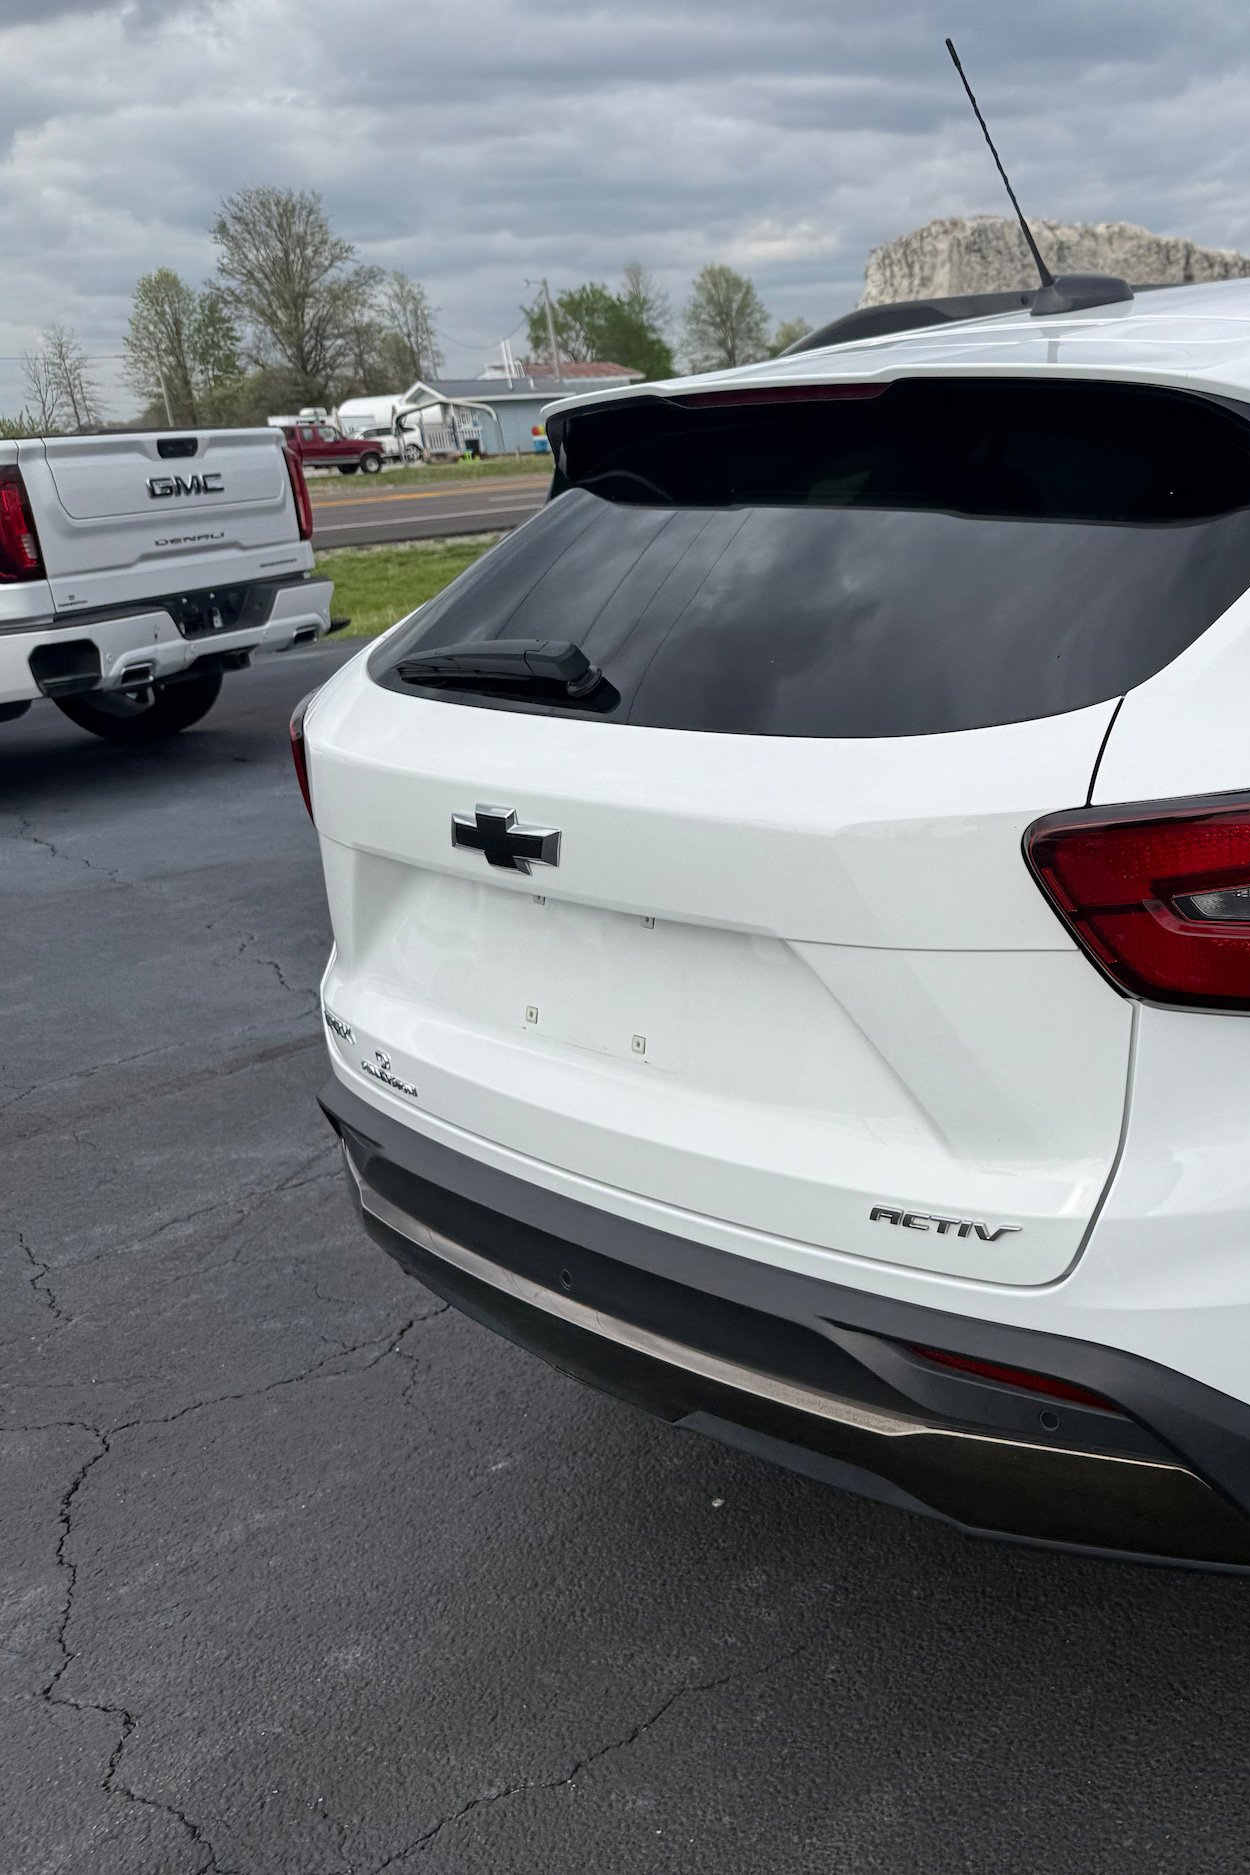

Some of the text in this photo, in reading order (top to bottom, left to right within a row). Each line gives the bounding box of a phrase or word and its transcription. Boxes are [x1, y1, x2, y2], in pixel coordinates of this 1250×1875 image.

[146, 473, 224, 499] GMC
[154, 532, 225, 547] DENALI
[869, 1204, 1024, 1242] ACTIV
